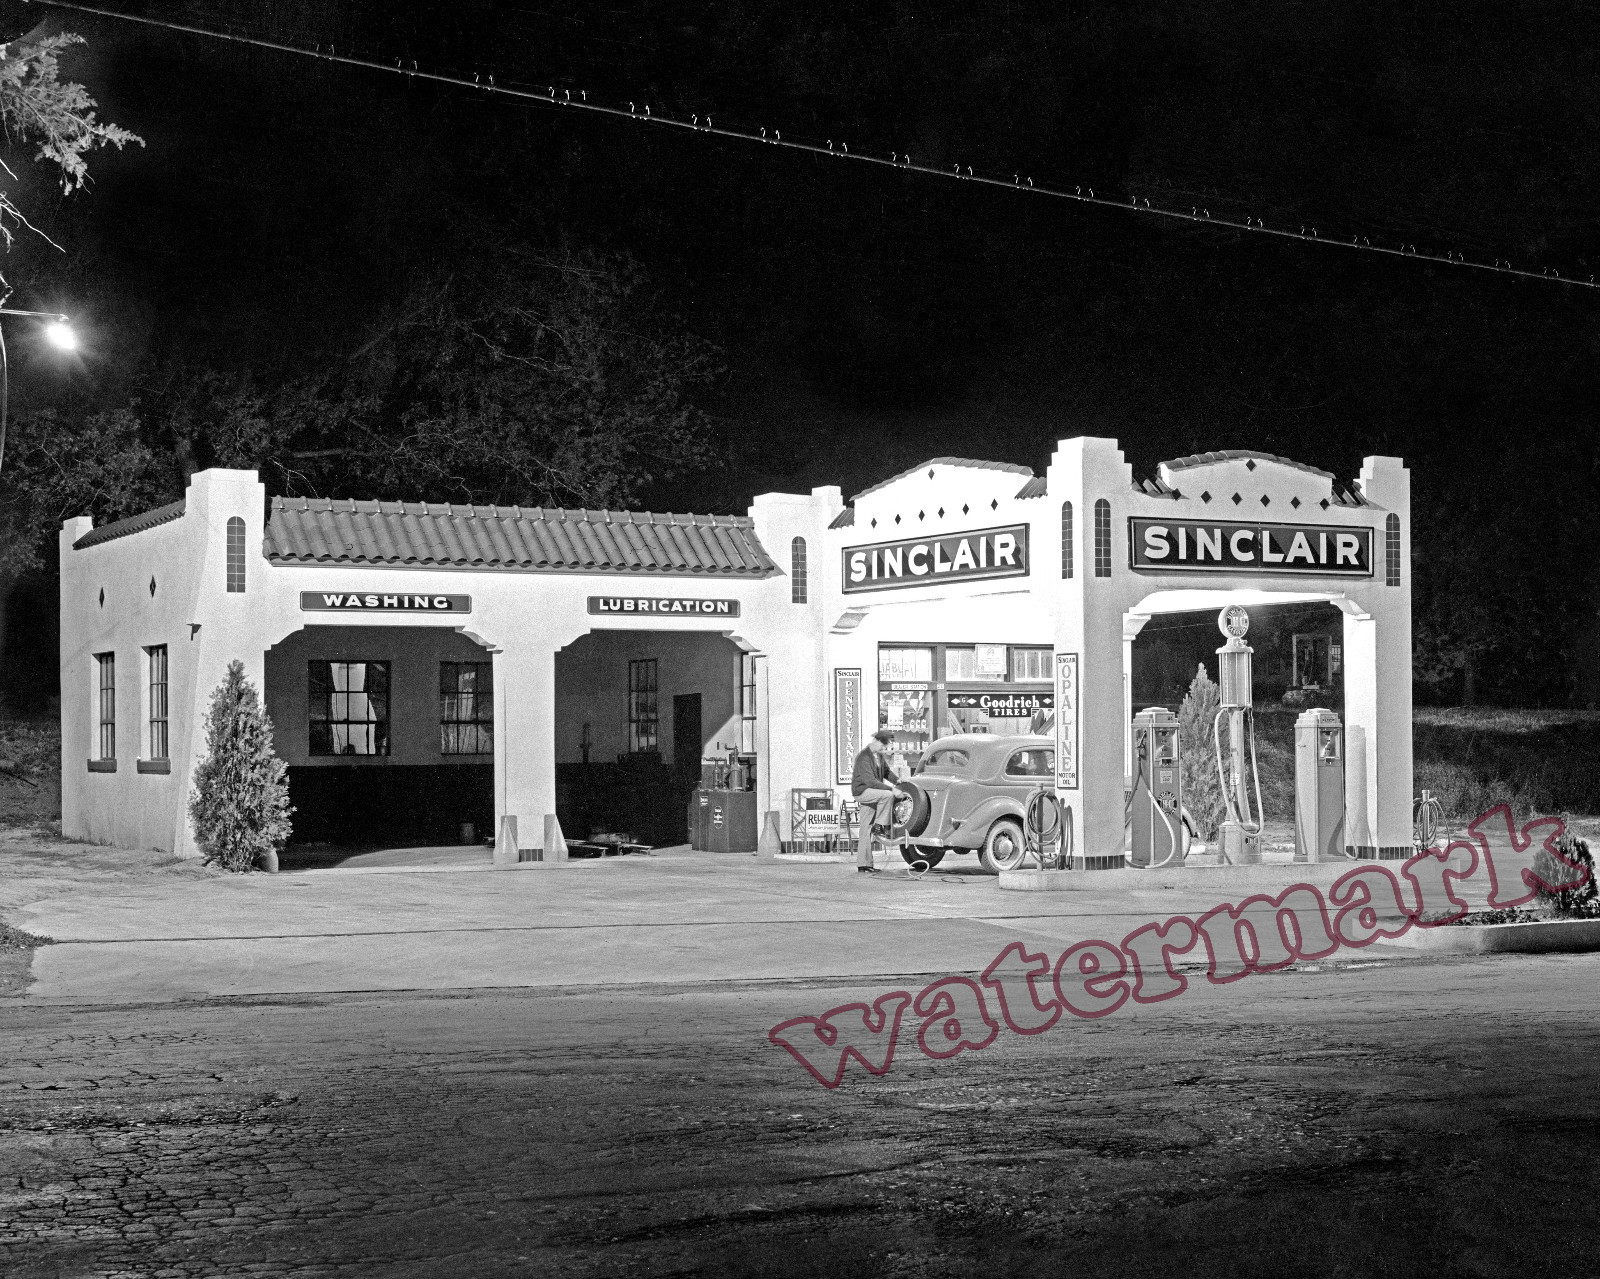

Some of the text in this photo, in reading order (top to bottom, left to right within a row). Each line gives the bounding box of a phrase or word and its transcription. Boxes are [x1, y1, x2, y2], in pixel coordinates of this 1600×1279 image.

[1143, 525, 1360, 566] SINCLAIR
[850, 533, 1016, 583] SINCLAIR
[322, 594, 448, 609] WASHING
[599, 598, 729, 613] LUBRICATION
[980, 695, 1040, 708] Goodrich
[993, 708, 1028, 716] TIRES
[1061, 664, 1073, 773] OPALINE
[845, 681, 855, 773] PENNSYLVANIA
[808, 813, 839, 825] RELIABLE
